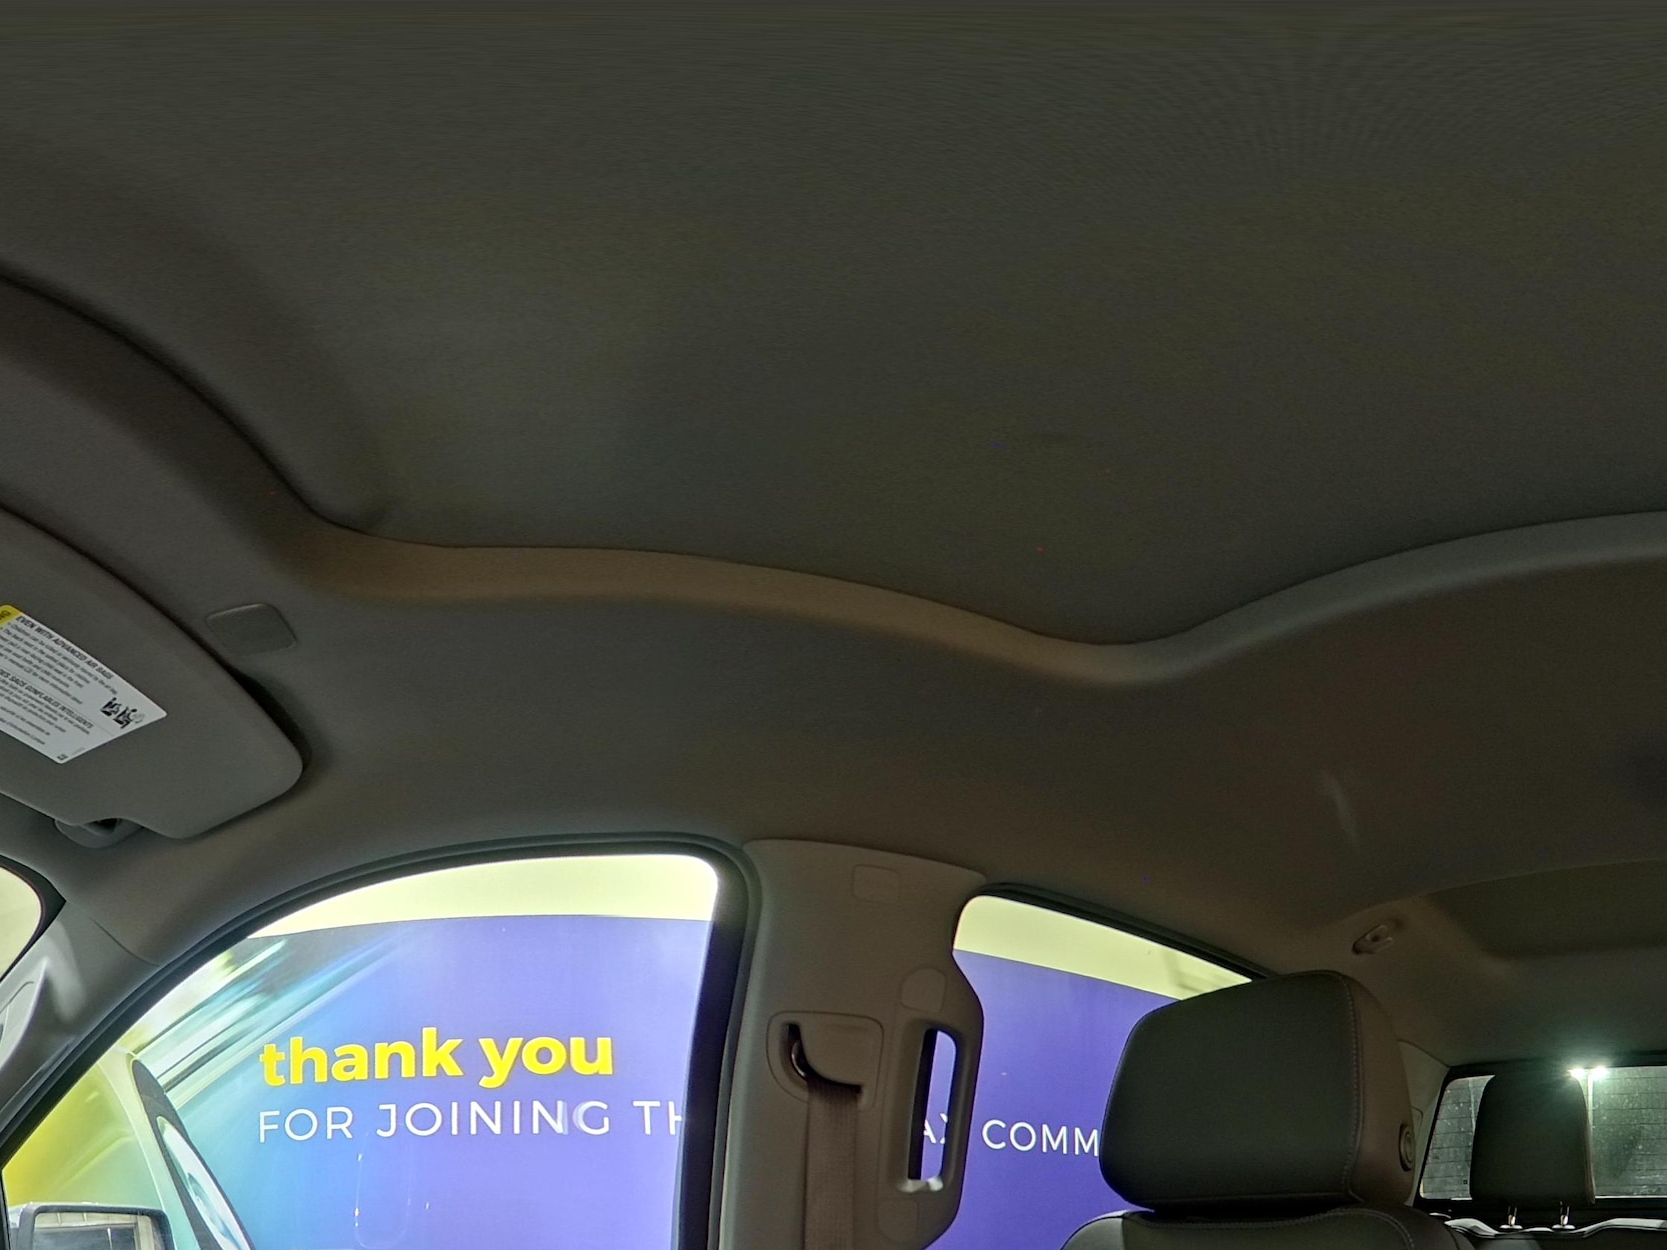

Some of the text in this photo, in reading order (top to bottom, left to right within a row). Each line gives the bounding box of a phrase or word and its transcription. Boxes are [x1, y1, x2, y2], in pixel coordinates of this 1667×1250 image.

[259, 1027, 613, 1089] thank you
[259, 1106, 354, 1143] FOR
[376, 1100, 610, 1138] JOINING
[982, 1119, 1099, 1157] COMM
